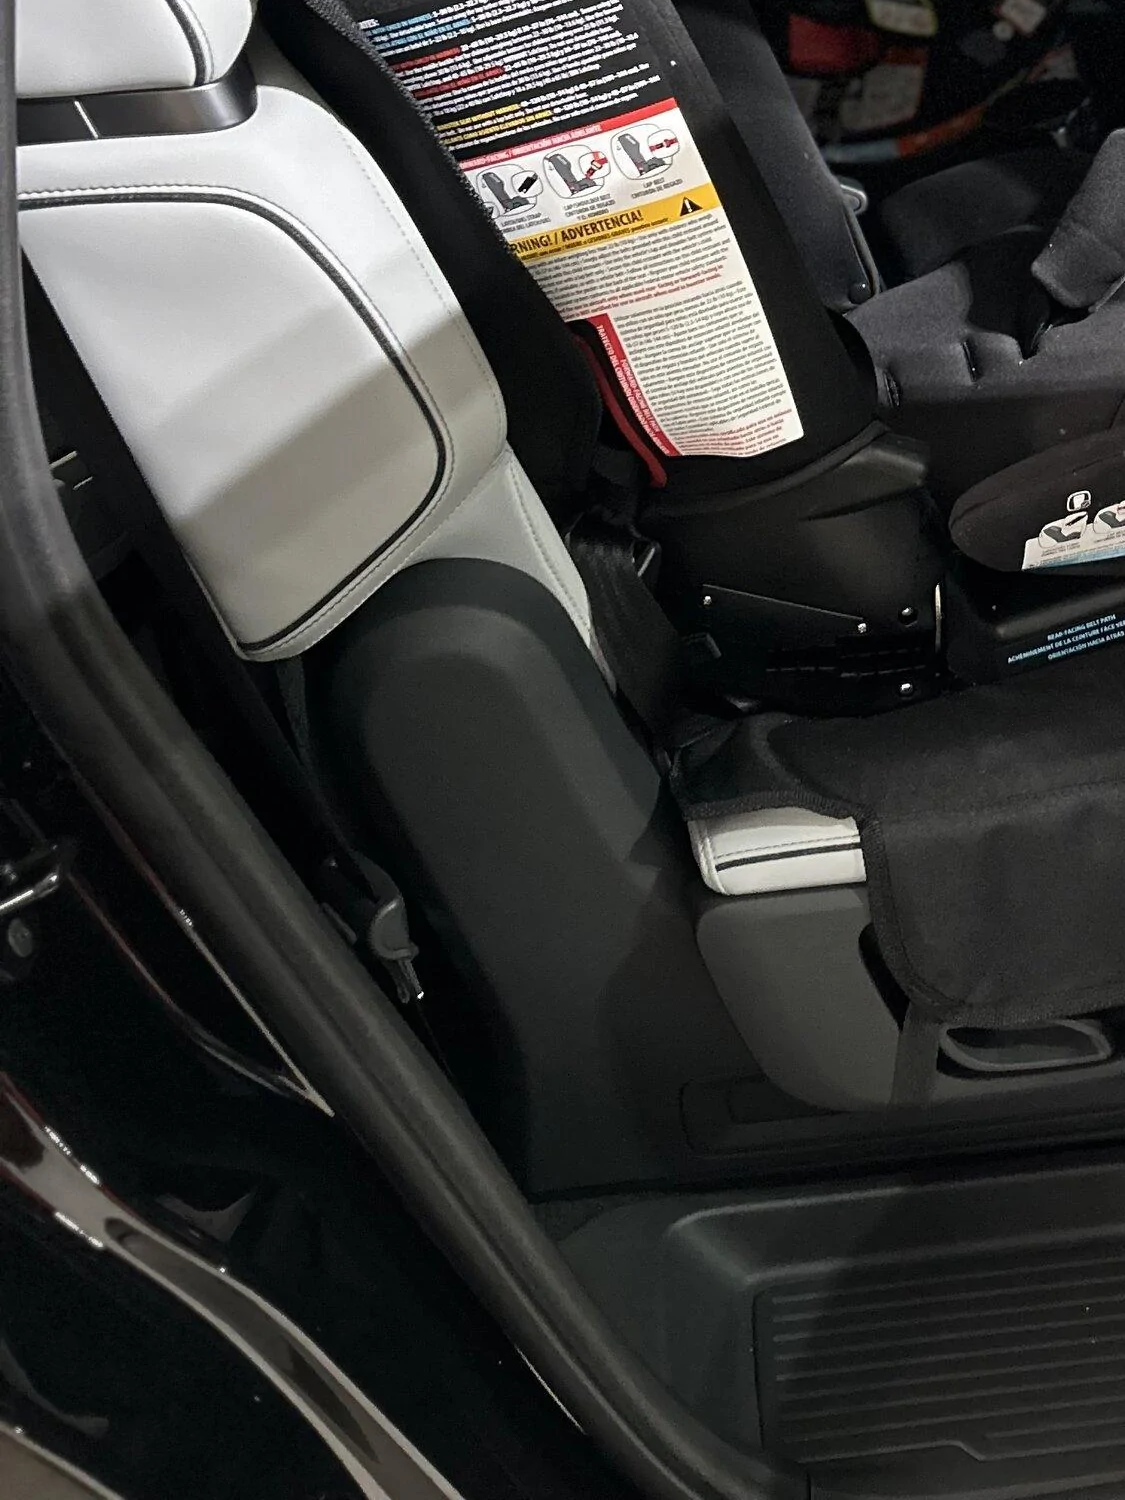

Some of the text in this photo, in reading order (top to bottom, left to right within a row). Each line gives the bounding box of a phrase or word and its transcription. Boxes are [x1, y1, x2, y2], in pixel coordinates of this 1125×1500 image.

[508, 208, 643, 254] RNING! / ADVERTENCIA!
